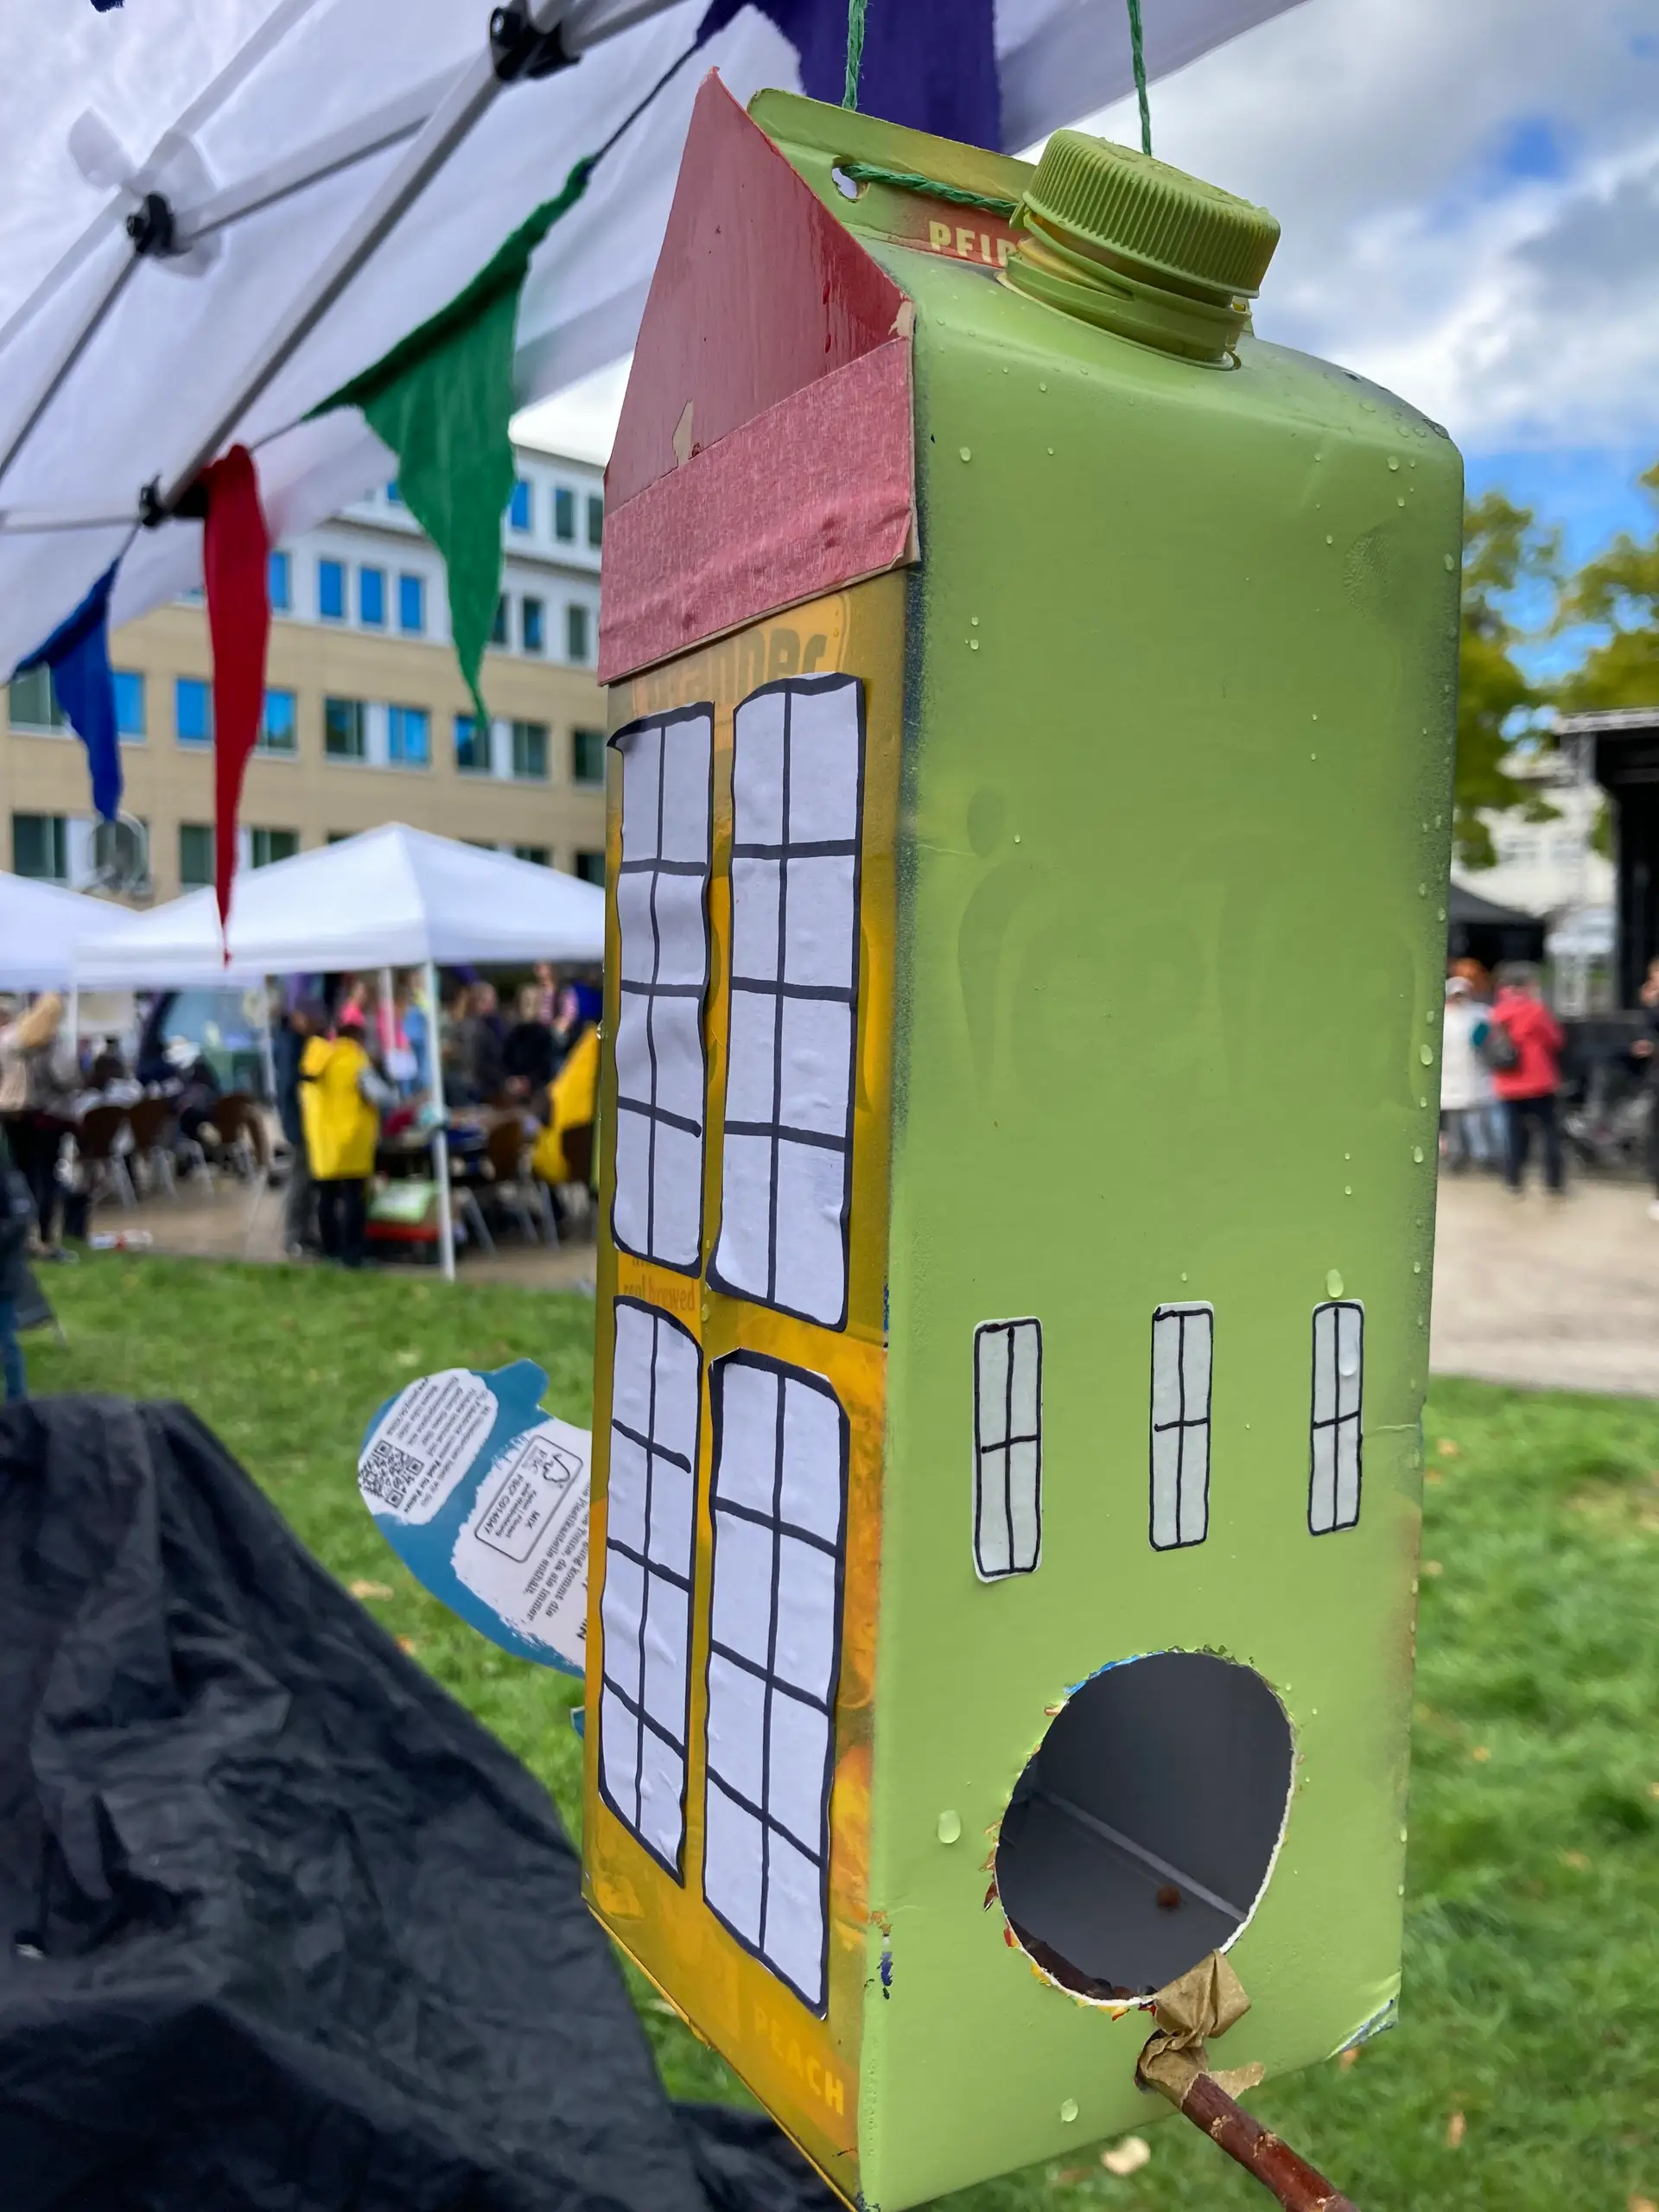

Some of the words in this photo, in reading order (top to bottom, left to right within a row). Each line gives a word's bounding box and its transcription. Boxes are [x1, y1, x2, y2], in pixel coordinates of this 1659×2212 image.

[524, 1510, 541, 1530] MIX
[554, 1559, 568, 1572] da
[545, 1571, 559, 1588] sie
[555, 1566, 581, 1601] kommt
[526, 1587, 551, 1622] immer
[544, 1600, 560, 1618] die
[753, 2003, 844, 2116] PEACH
